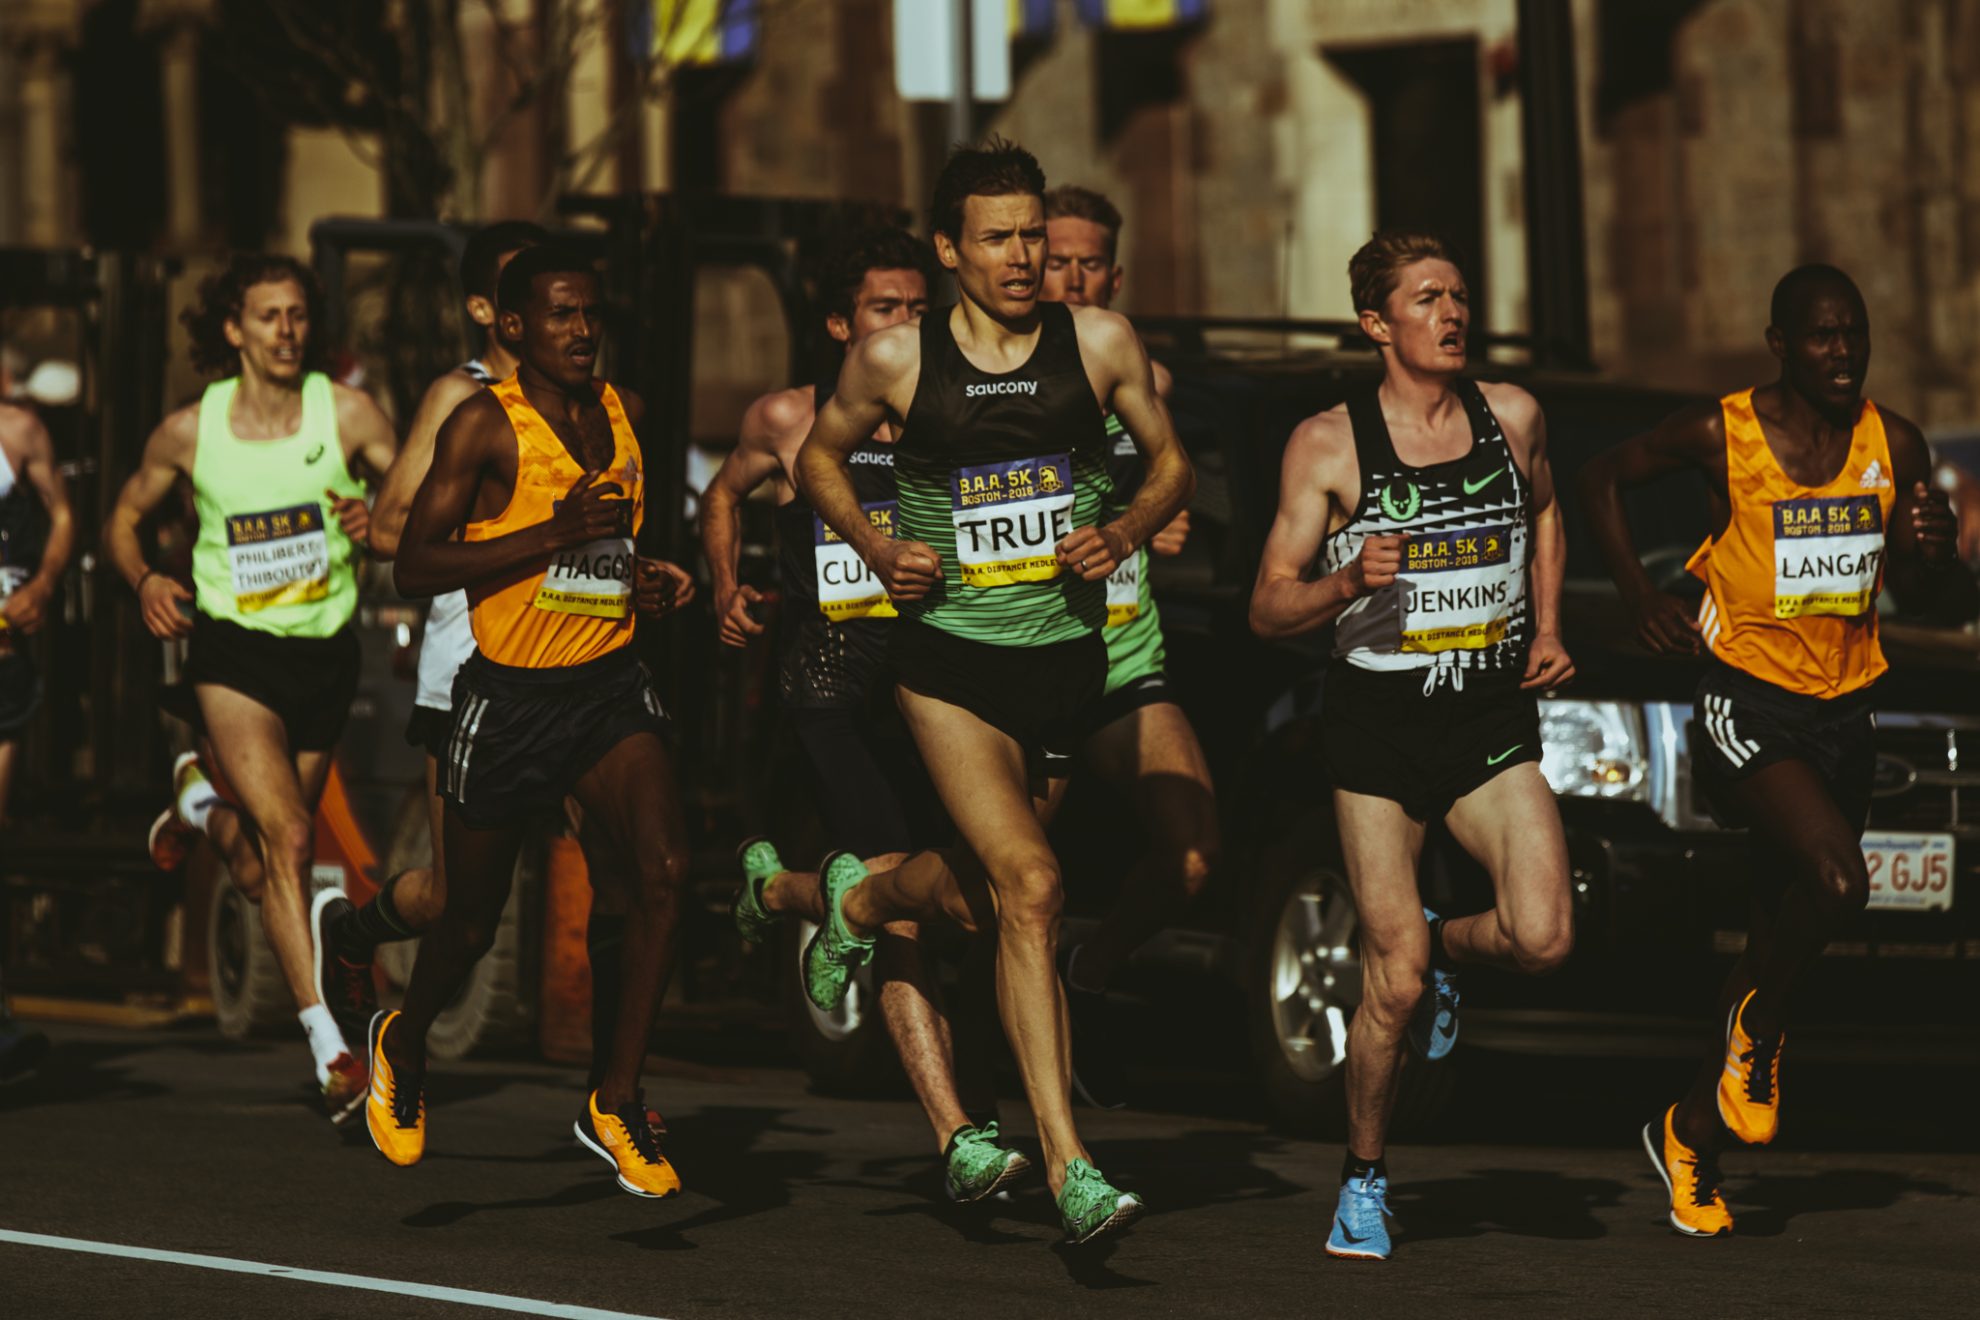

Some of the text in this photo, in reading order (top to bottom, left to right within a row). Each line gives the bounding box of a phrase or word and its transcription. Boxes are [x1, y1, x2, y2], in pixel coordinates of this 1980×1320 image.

[966, 381, 1038, 397] saucony
[959, 469, 1032, 494] B.A.A. 5K
[870, 509, 892, 526] 5K
[1828, 505, 1851, 522] 5K
[959, 506, 1070, 552] TRUE
[1408, 537, 1478, 558] B.A.A. 5K
[987, 562, 1027, 573] DISTANCE
[1782, 550, 1880, 578] LANGAT
[1404, 580, 1507, 614] JENKINS
[1427, 629, 1466, 640] DISTANCE
[1891, 852, 1948, 892] GJ5
